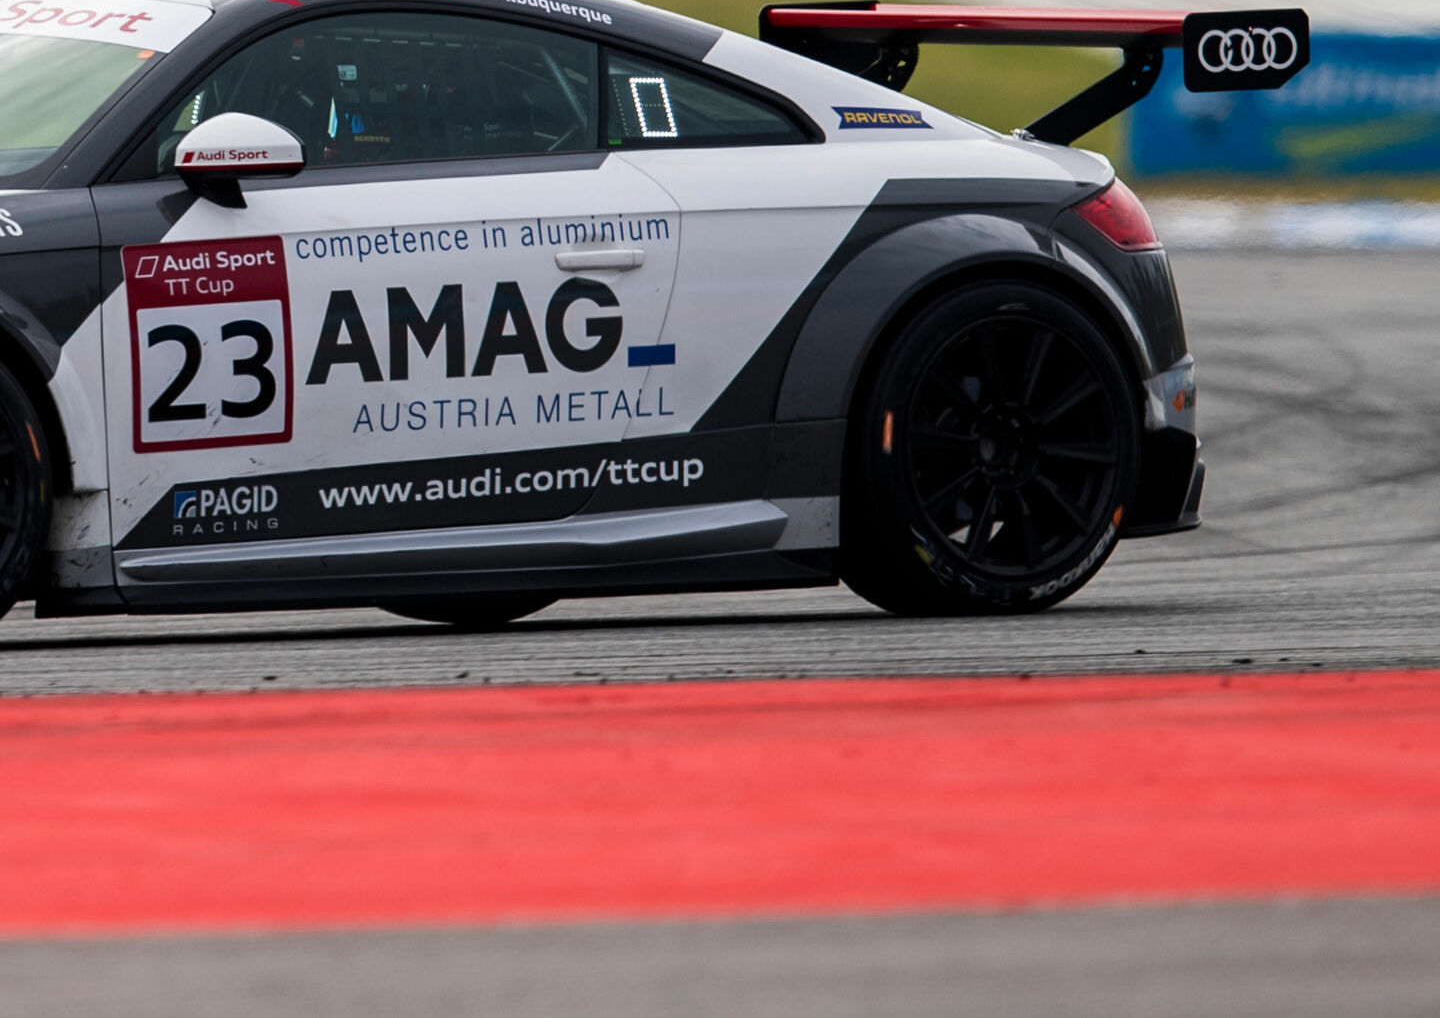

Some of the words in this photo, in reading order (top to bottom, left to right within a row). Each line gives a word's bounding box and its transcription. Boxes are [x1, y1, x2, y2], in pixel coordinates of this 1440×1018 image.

[843, 112, 922, 125] RAVENOL
[197, 150, 226, 161] Audi
[228, 149, 268, 161] Sport
[295, 226, 469, 262] competence
[481, 220, 507, 248] in
[520, 214, 670, 246] aluminium
[163, 252, 211, 272] Audi
[215, 249, 276, 271] Sport
[164, 278, 191, 296] TT
[195, 278, 234, 296] Cup
[305, 276, 623, 385] AMAG
[147, 319, 276, 423] 23
[353, 396, 517, 433] AUSTRIA
[536, 386, 675, 424] METALL
[318, 457, 705, 508] www.audi.com/ttcup
[200, 485, 278, 517] PAGID
[173, 518, 279, 535] RACING
